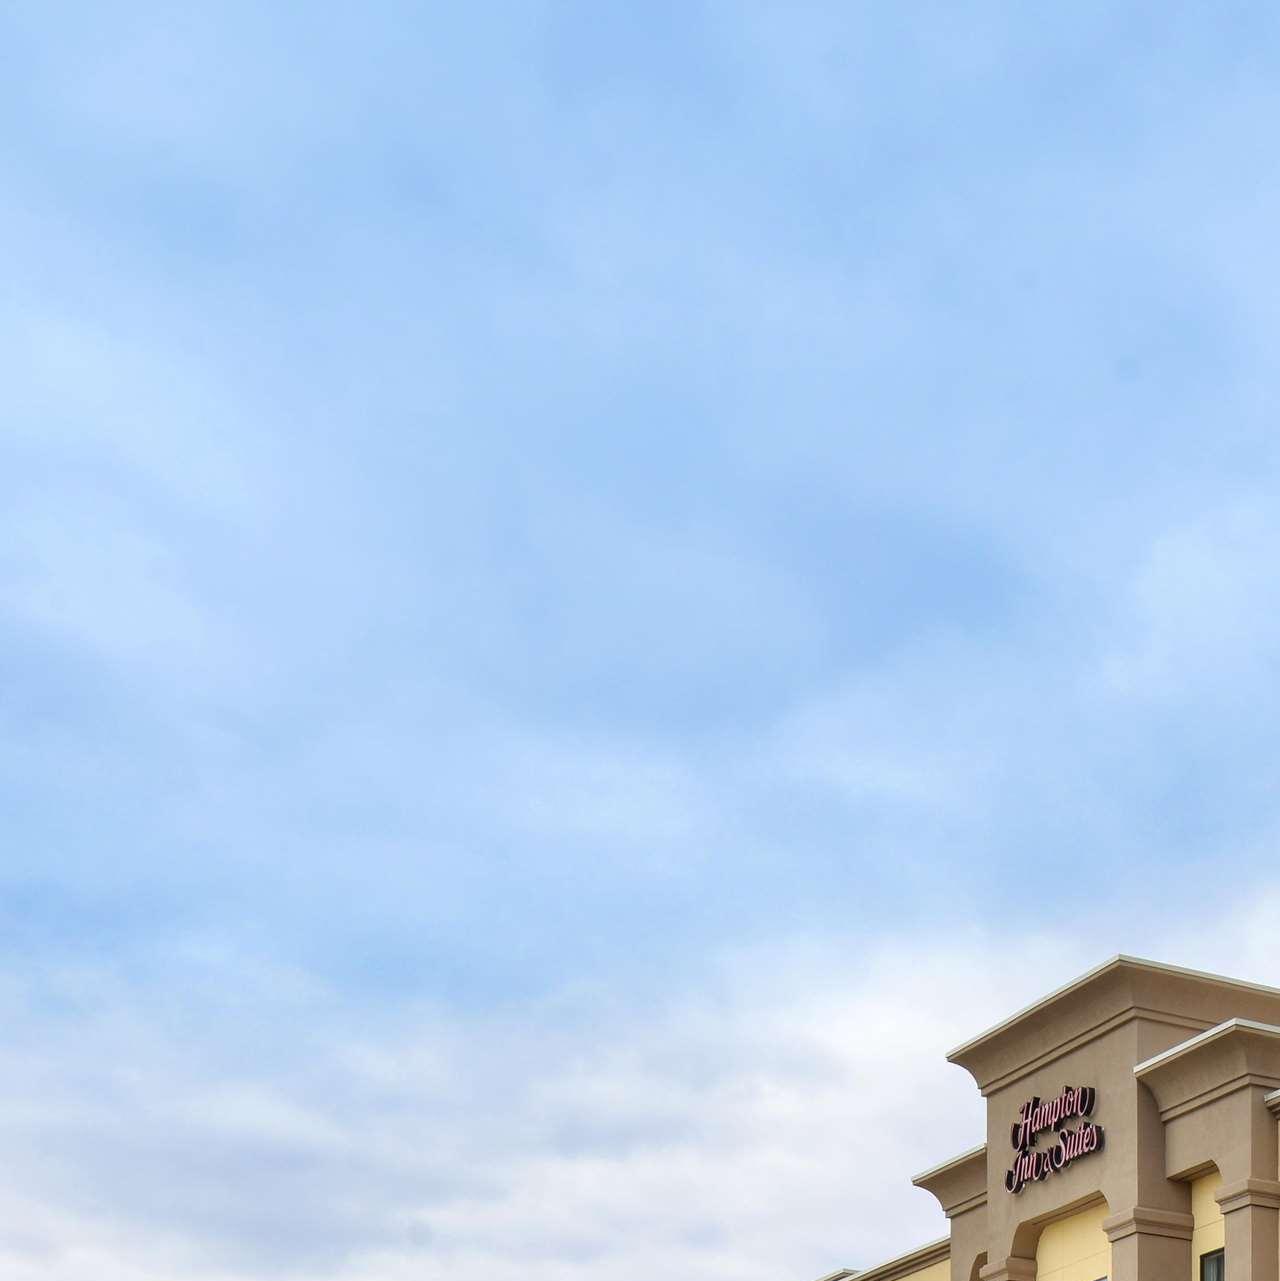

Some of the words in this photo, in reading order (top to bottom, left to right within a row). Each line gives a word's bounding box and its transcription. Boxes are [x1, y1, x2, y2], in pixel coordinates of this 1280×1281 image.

[1012, 1086, 1095, 1151] Hampton
[1005, 1150, 1044, 1193] Inn
[1053, 1122, 1103, 1168] Suites
